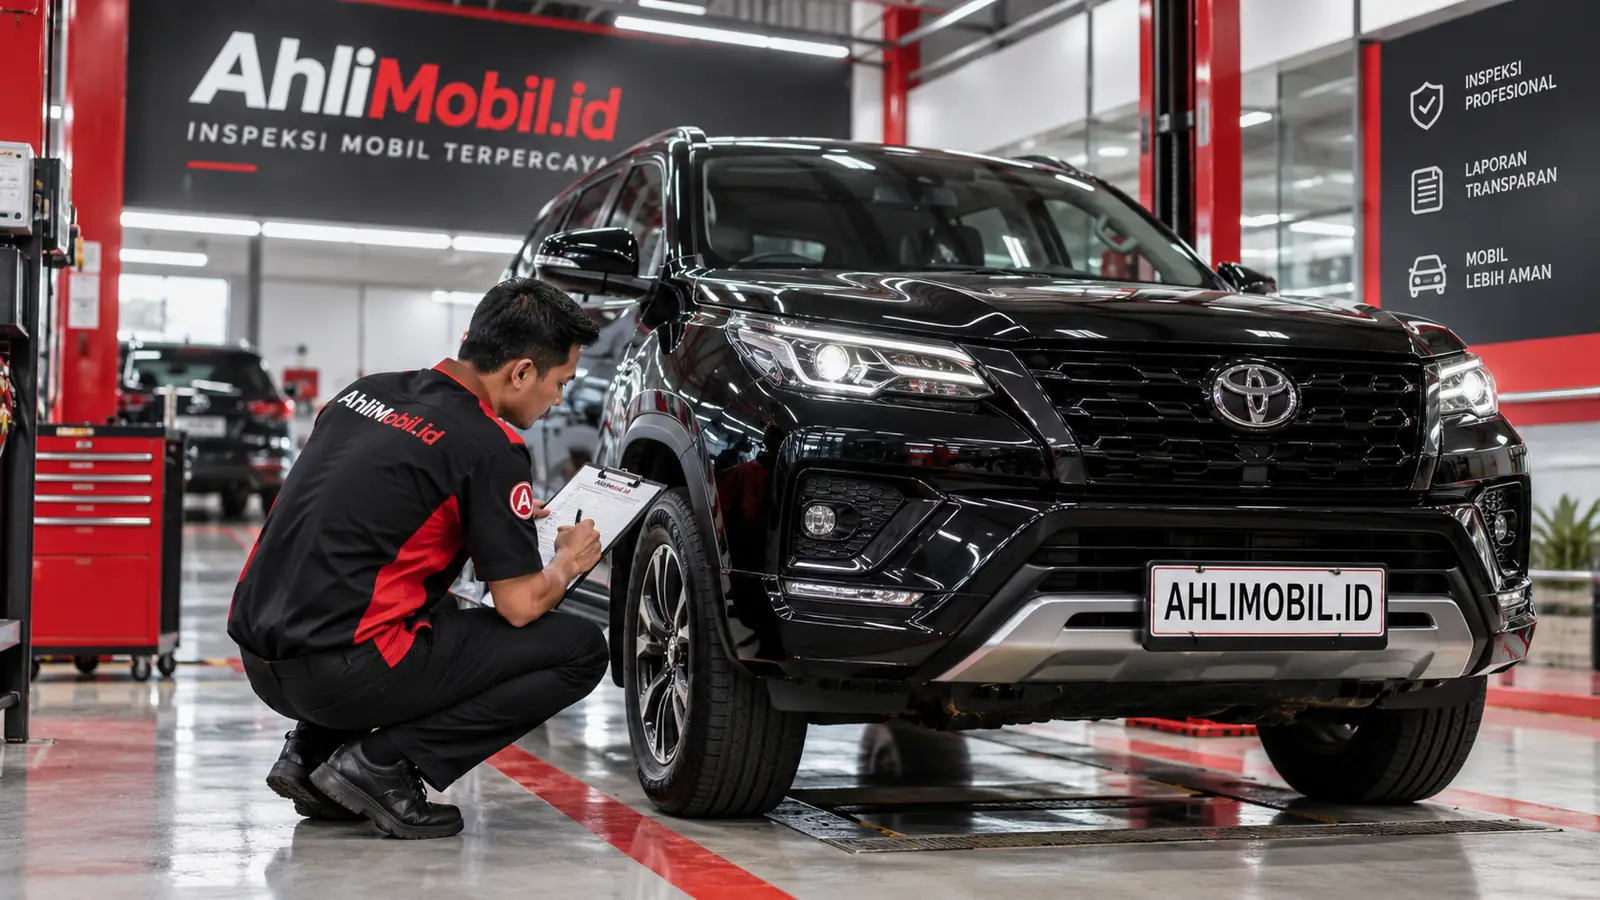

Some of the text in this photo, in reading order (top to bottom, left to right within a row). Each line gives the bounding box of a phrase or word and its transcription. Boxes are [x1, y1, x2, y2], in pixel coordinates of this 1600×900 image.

[188, 31, 623, 142] AhliMobil.id
[1465, 60, 1523, 89] INSPEKSI
[1465, 74, 1557, 110] PROFESIONAL
[187, 121, 328, 152] INSPEKSI
[340, 134, 430, 160] MOBIL
[1465, 150, 1528, 177] LAPORAN
[1465, 166, 1558, 199] TRANSPARAN
[1465, 247, 1508, 267] MOBIL
[1465, 263, 1552, 289] LEBIH AMAN
[337, 389, 446, 446] AhliMobil.id
[517, 488, 531, 511] A
[1164, 581, 1374, 622] AHLIMOBIL.ID
